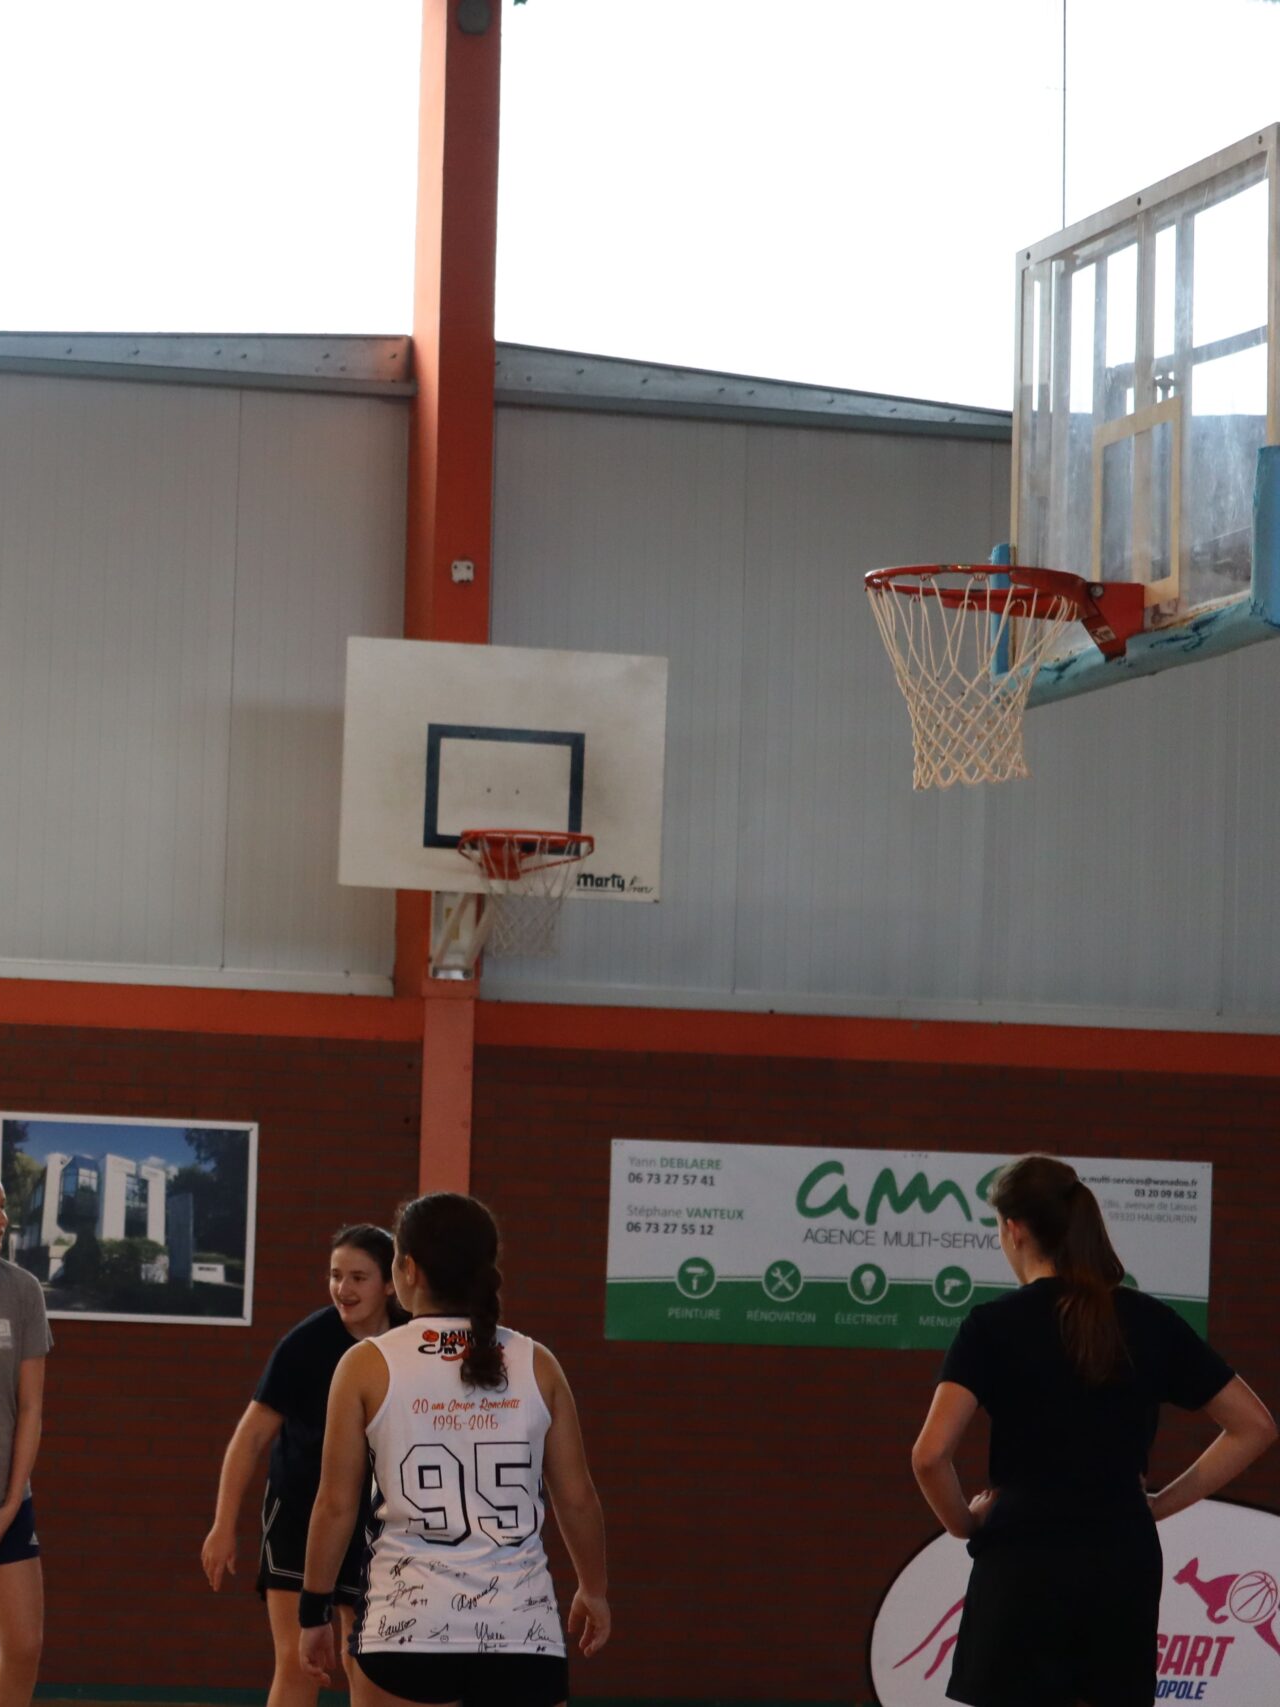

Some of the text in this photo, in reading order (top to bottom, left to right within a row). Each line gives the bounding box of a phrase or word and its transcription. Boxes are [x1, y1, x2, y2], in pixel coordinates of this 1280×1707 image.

[660, 1157, 722, 1170] DEBLAERE
[628, 1172, 715, 1186] 06 73 27 57 41
[1148, 1189, 1159, 1198] 20
[626, 1204, 744, 1220] Stéphane VANTEUX
[626, 1222, 714, 1235] 06 73 27 55 12
[803, 1228, 1001, 1250] AGENCE MULTI-SERVIC
[668, 1306, 720, 1320] PEINTURE
[919, 1314, 963, 1328] MENUIS
[399, 1441, 538, 1548] 95
[1156, 1680, 1208, 1701] OPOLE
